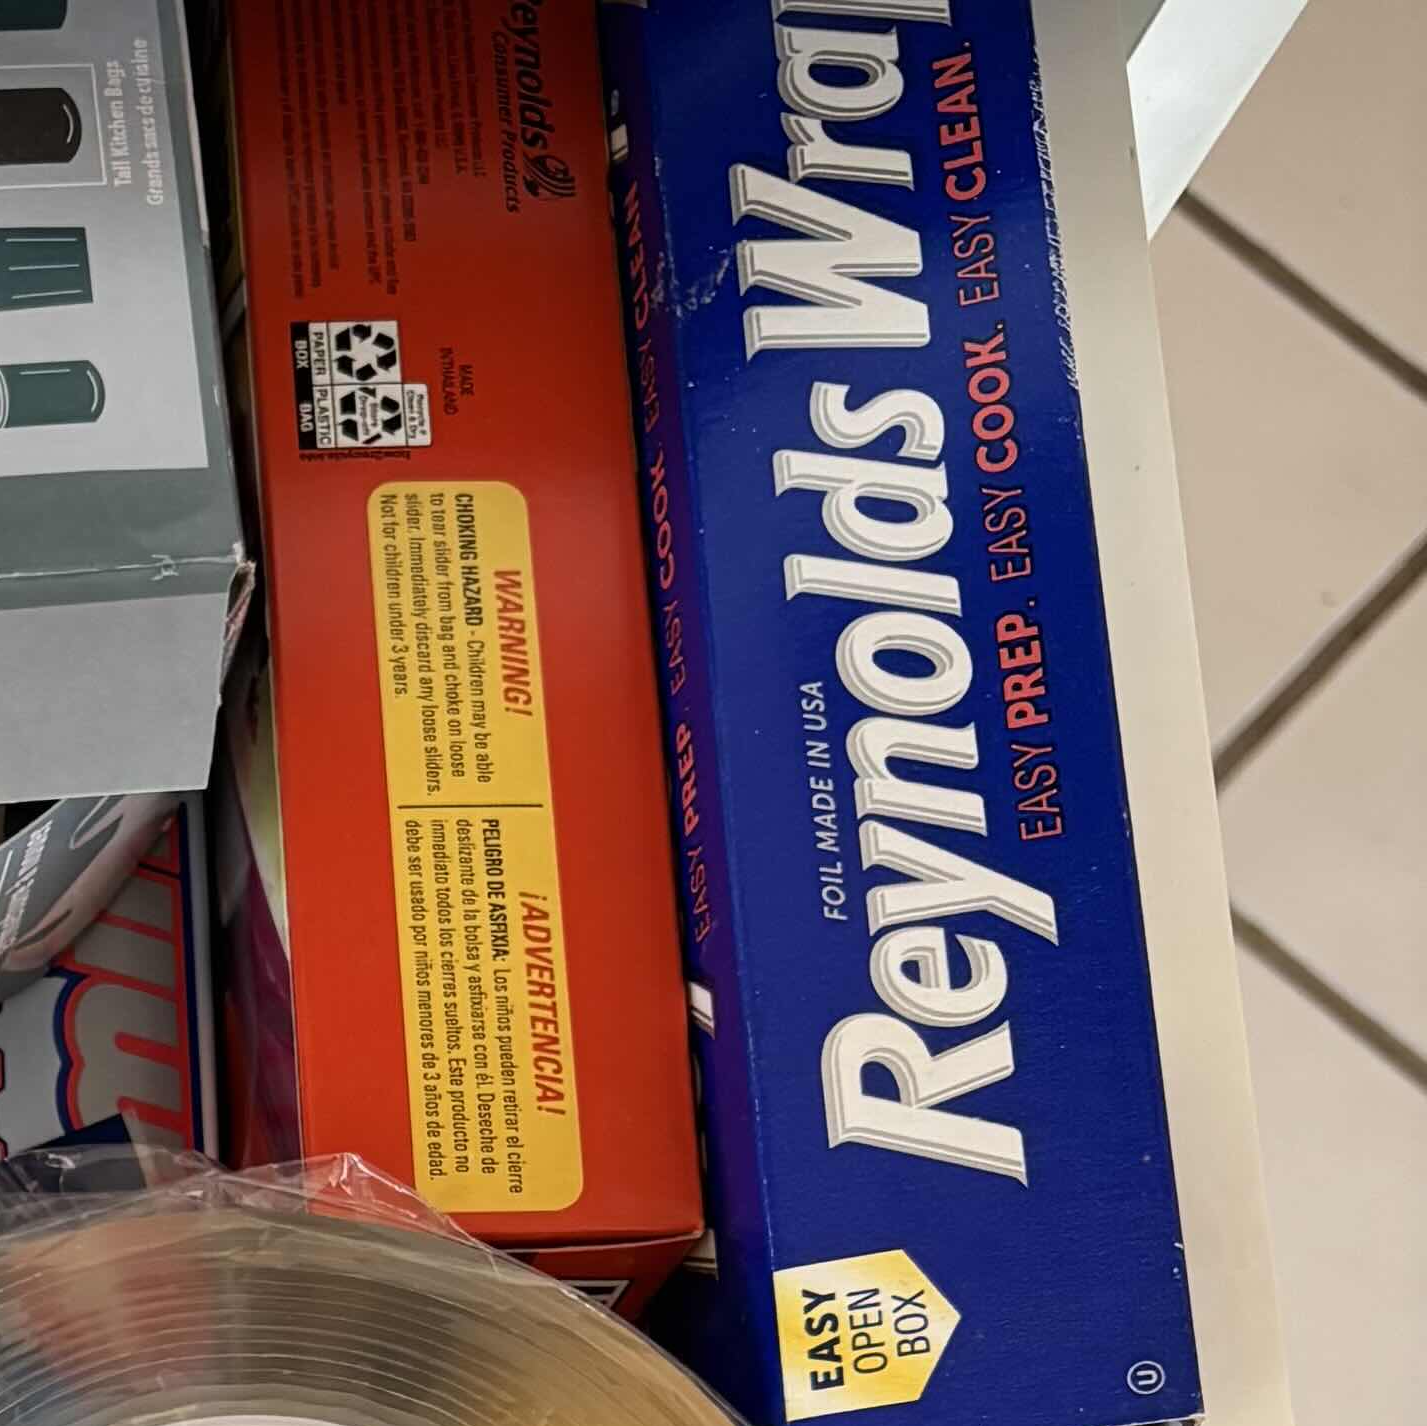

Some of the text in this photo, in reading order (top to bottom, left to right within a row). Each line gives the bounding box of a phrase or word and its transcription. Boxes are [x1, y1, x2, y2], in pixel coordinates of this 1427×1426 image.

[932, 41, 1063, 841] EASY PREP. EASY COOK. EASY CLEAN.
[493, 569, 534, 717] WARNING!
[662, 599, 687, 696] EASY
[773, 382, 1059, 1188] Reynolds
[799, 681, 848, 922] FOIL MADE IN USA
[686, 844, 712, 943] EASY
[518, 891, 567, 1116] ¡ADVERTENCIA!
[801, 1288, 845, 1391] EASY
[845, 1287, 888, 1374] OPEN
[890, 1288, 931, 1357] BOX
